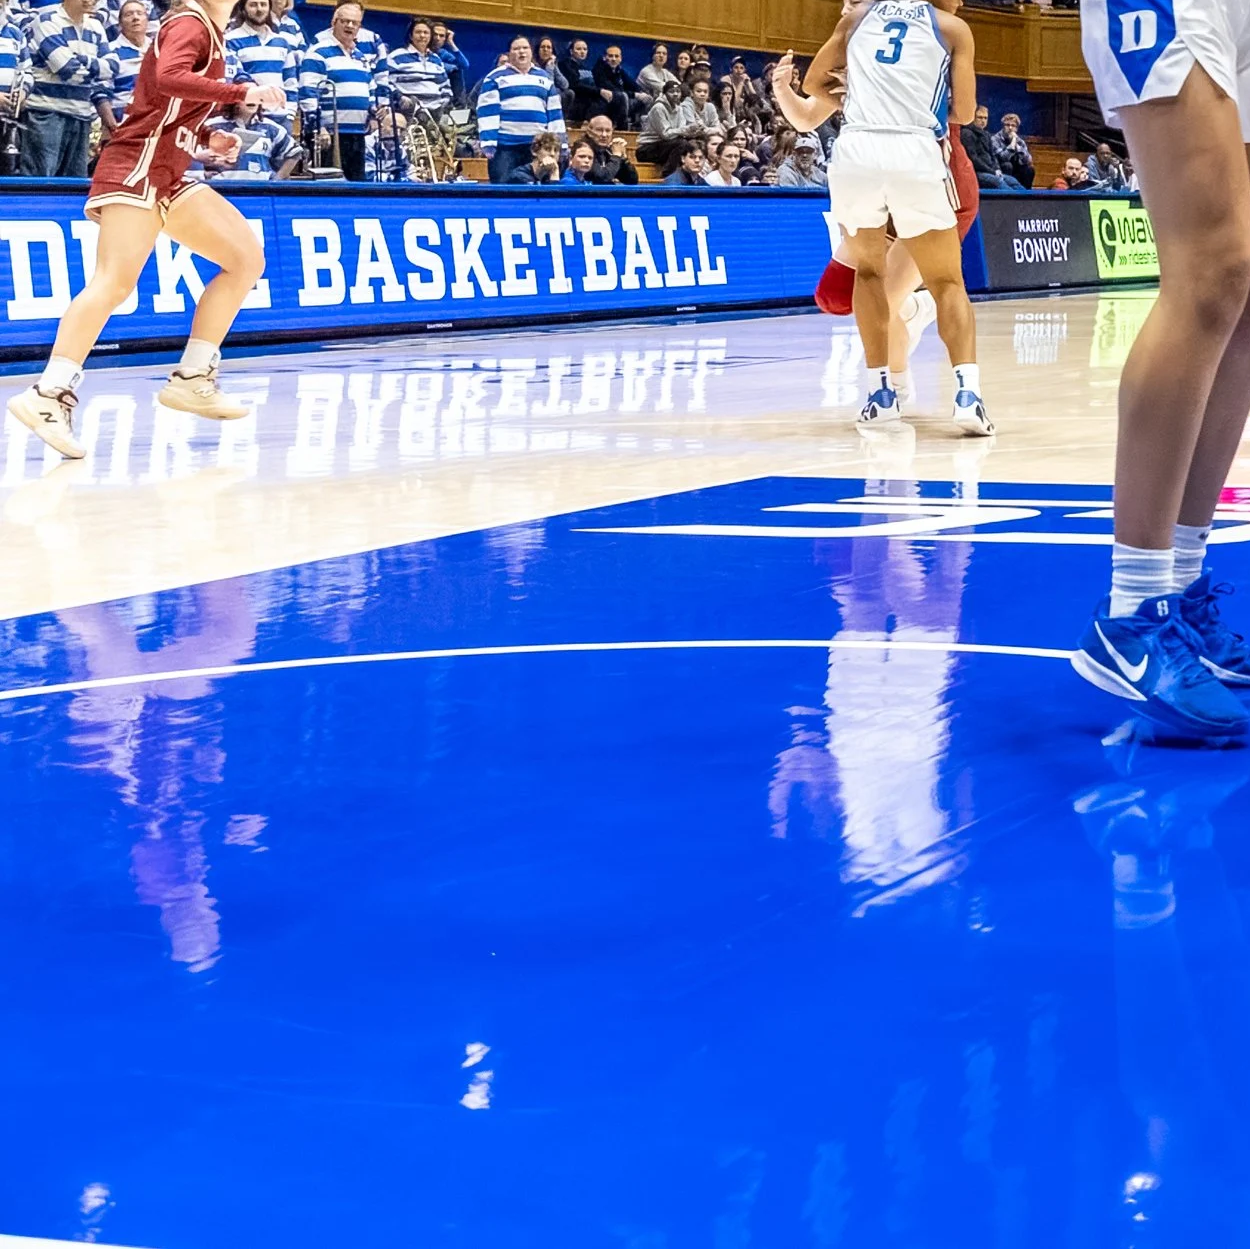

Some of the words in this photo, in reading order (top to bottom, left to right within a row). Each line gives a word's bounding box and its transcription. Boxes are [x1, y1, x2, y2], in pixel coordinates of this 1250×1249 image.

[875, 21, 909, 65] 3
[1017, 219, 1059, 233] MARRIOTT
[291, 215, 728, 308] BASKETBALL
[1012, 237, 1070, 264] BONVOY
